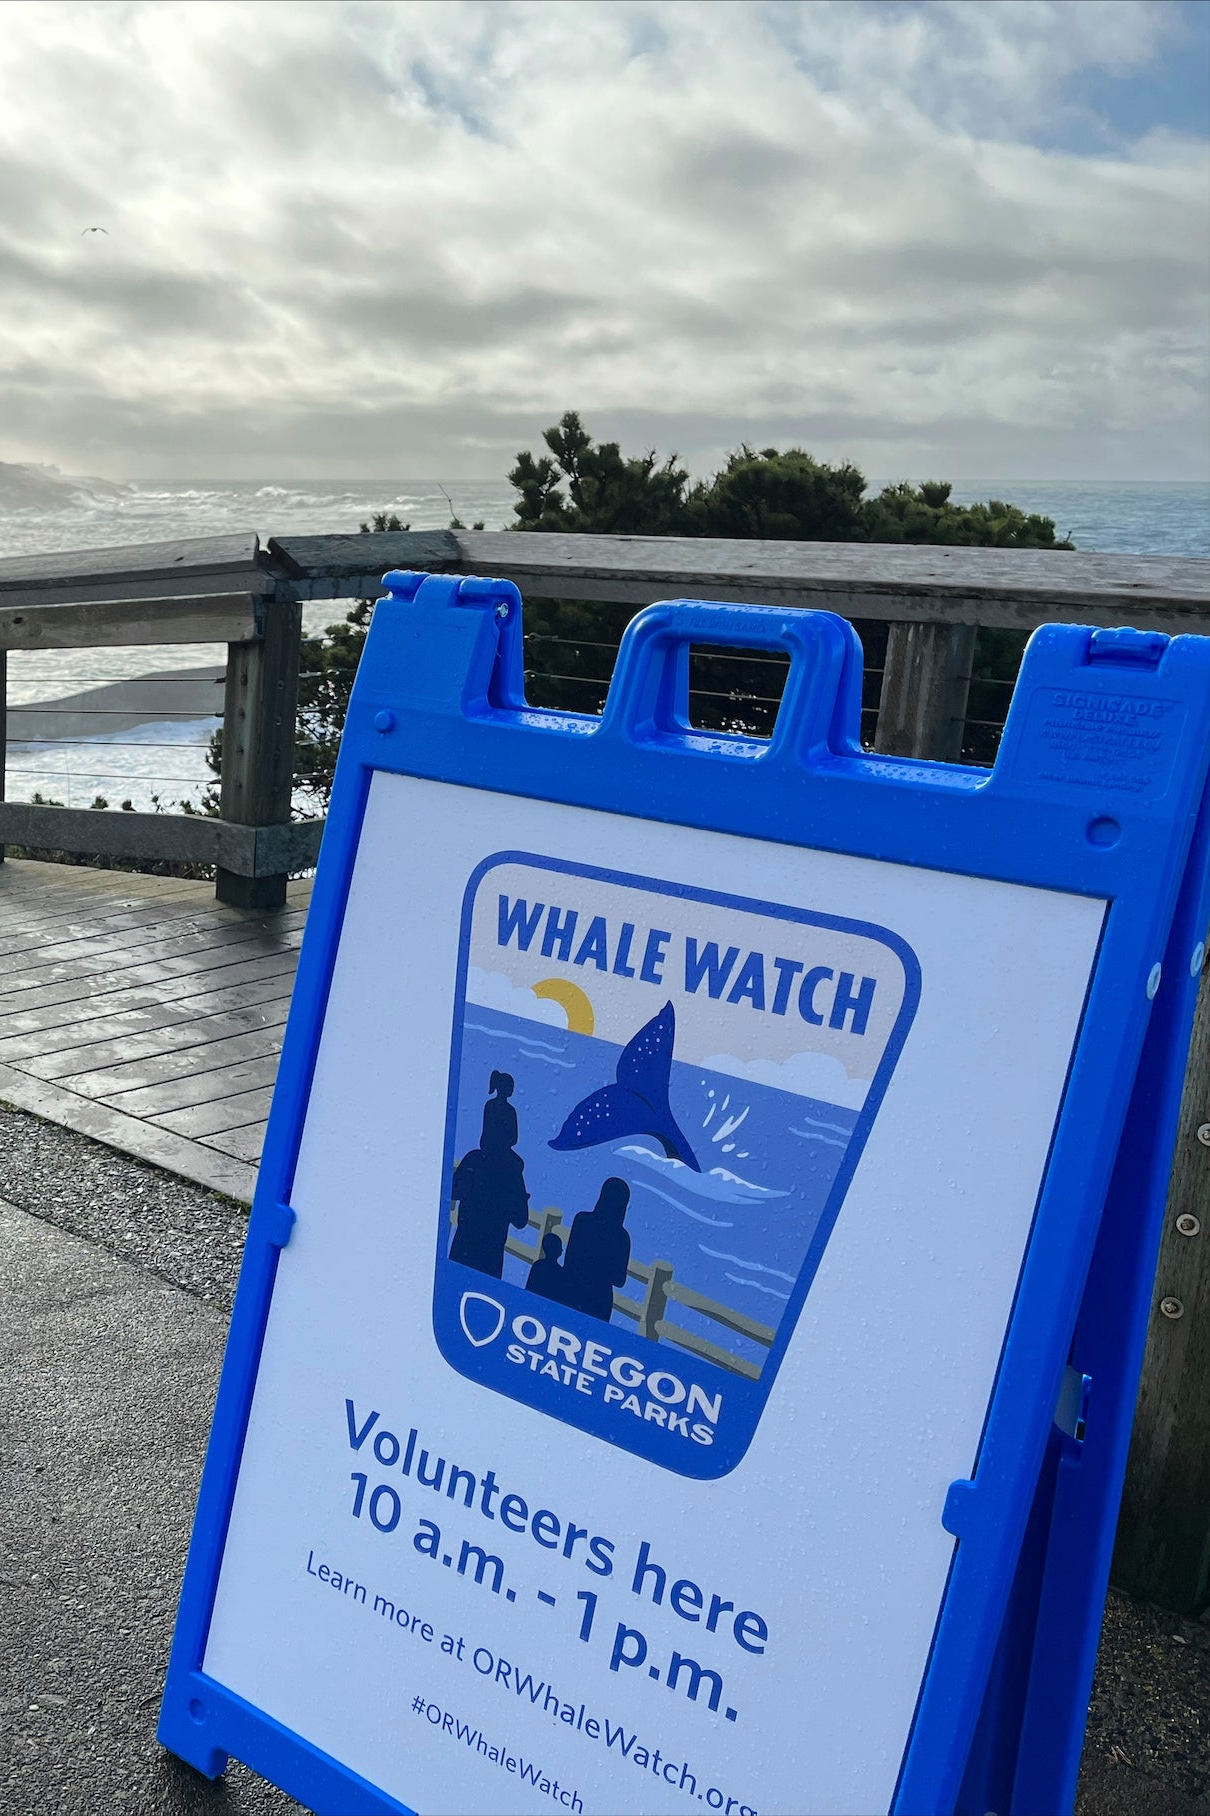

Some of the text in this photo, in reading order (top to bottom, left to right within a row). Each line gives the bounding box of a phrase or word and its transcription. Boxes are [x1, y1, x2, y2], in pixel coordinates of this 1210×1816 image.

[1053, 692, 1165, 720] SIGNICADE
[1072, 710, 1136, 728] DELUXE
[497, 894, 877, 1036] WHALE WATCH
[505, 1344, 715, 1446] STATE PARKS
[511, 1315, 723, 1425] OREGON
[345, 1398, 769, 1655] Volunteers here
[306, 1550, 367, 1604] Learn
[373, 1591, 435, 1643] more
[440, 1634, 466, 1663] at
[349, 1472, 402, 1534] 10
[413, 1518, 518, 1602] a.m.
[575, 1591, 598, 1643] 1
[609, 1622, 739, 1723] p.m.
[410, 1695, 585, 1814] #ORWhaleWatch
